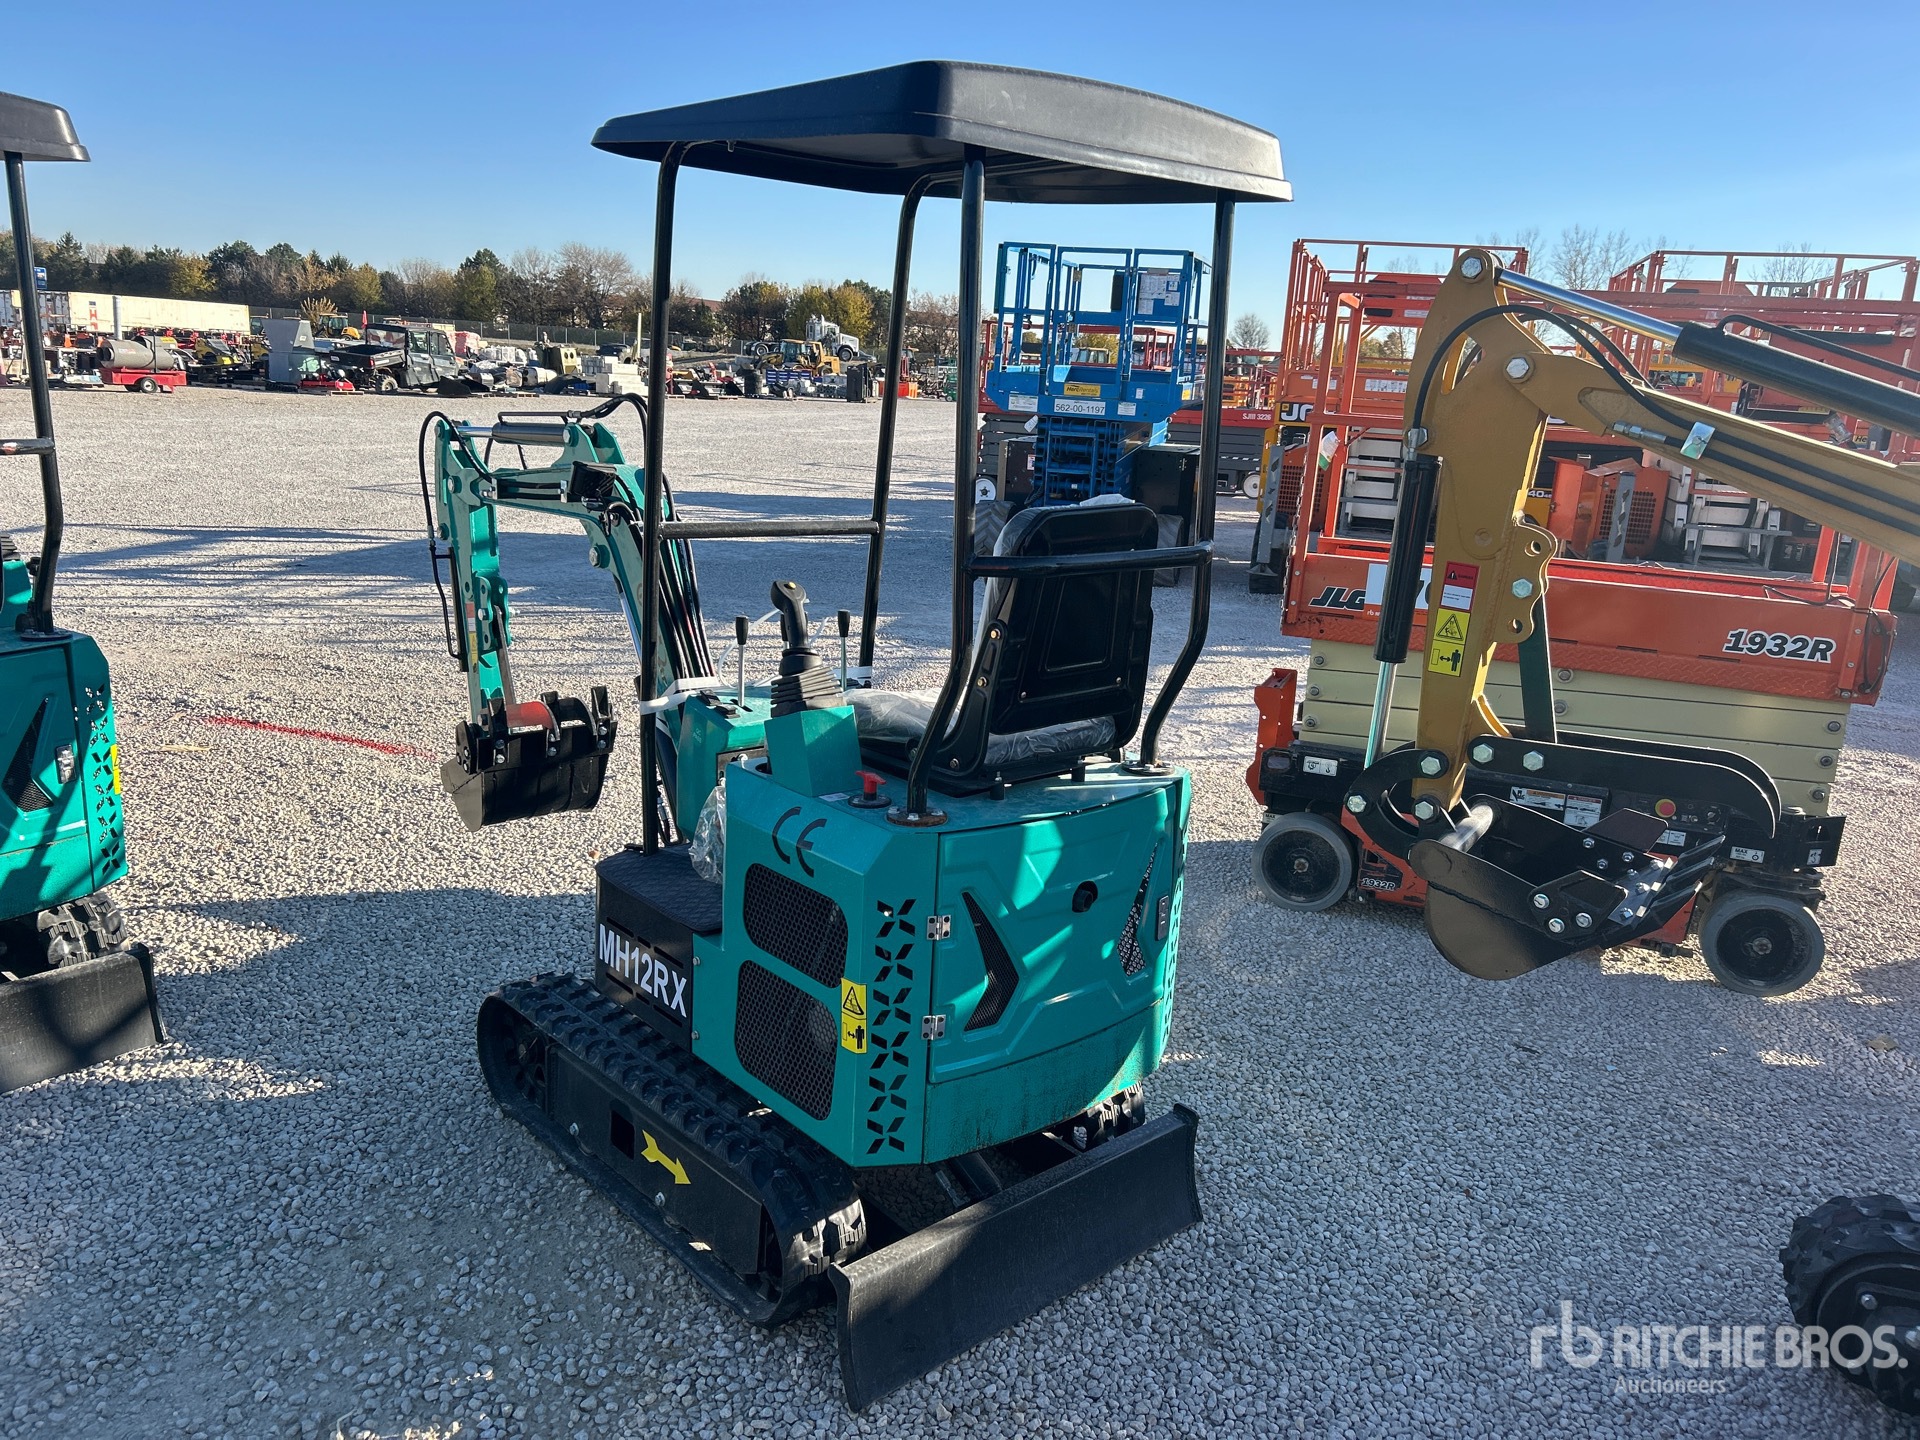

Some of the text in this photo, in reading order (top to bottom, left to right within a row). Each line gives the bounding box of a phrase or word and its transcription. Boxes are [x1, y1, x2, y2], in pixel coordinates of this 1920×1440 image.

[1055, 403, 1105, 414] 562-00-1197
[1256, 413, 1272, 421] 3226
[1281, 403, 1314, 422] JC
[1308, 586, 1366, 611] JLG
[1722, 628, 1836, 663] 1932R
[772, 806, 827, 878] CE
[1362, 878, 1396, 891] 1932R
[599, 923, 688, 1018] MH12RX
